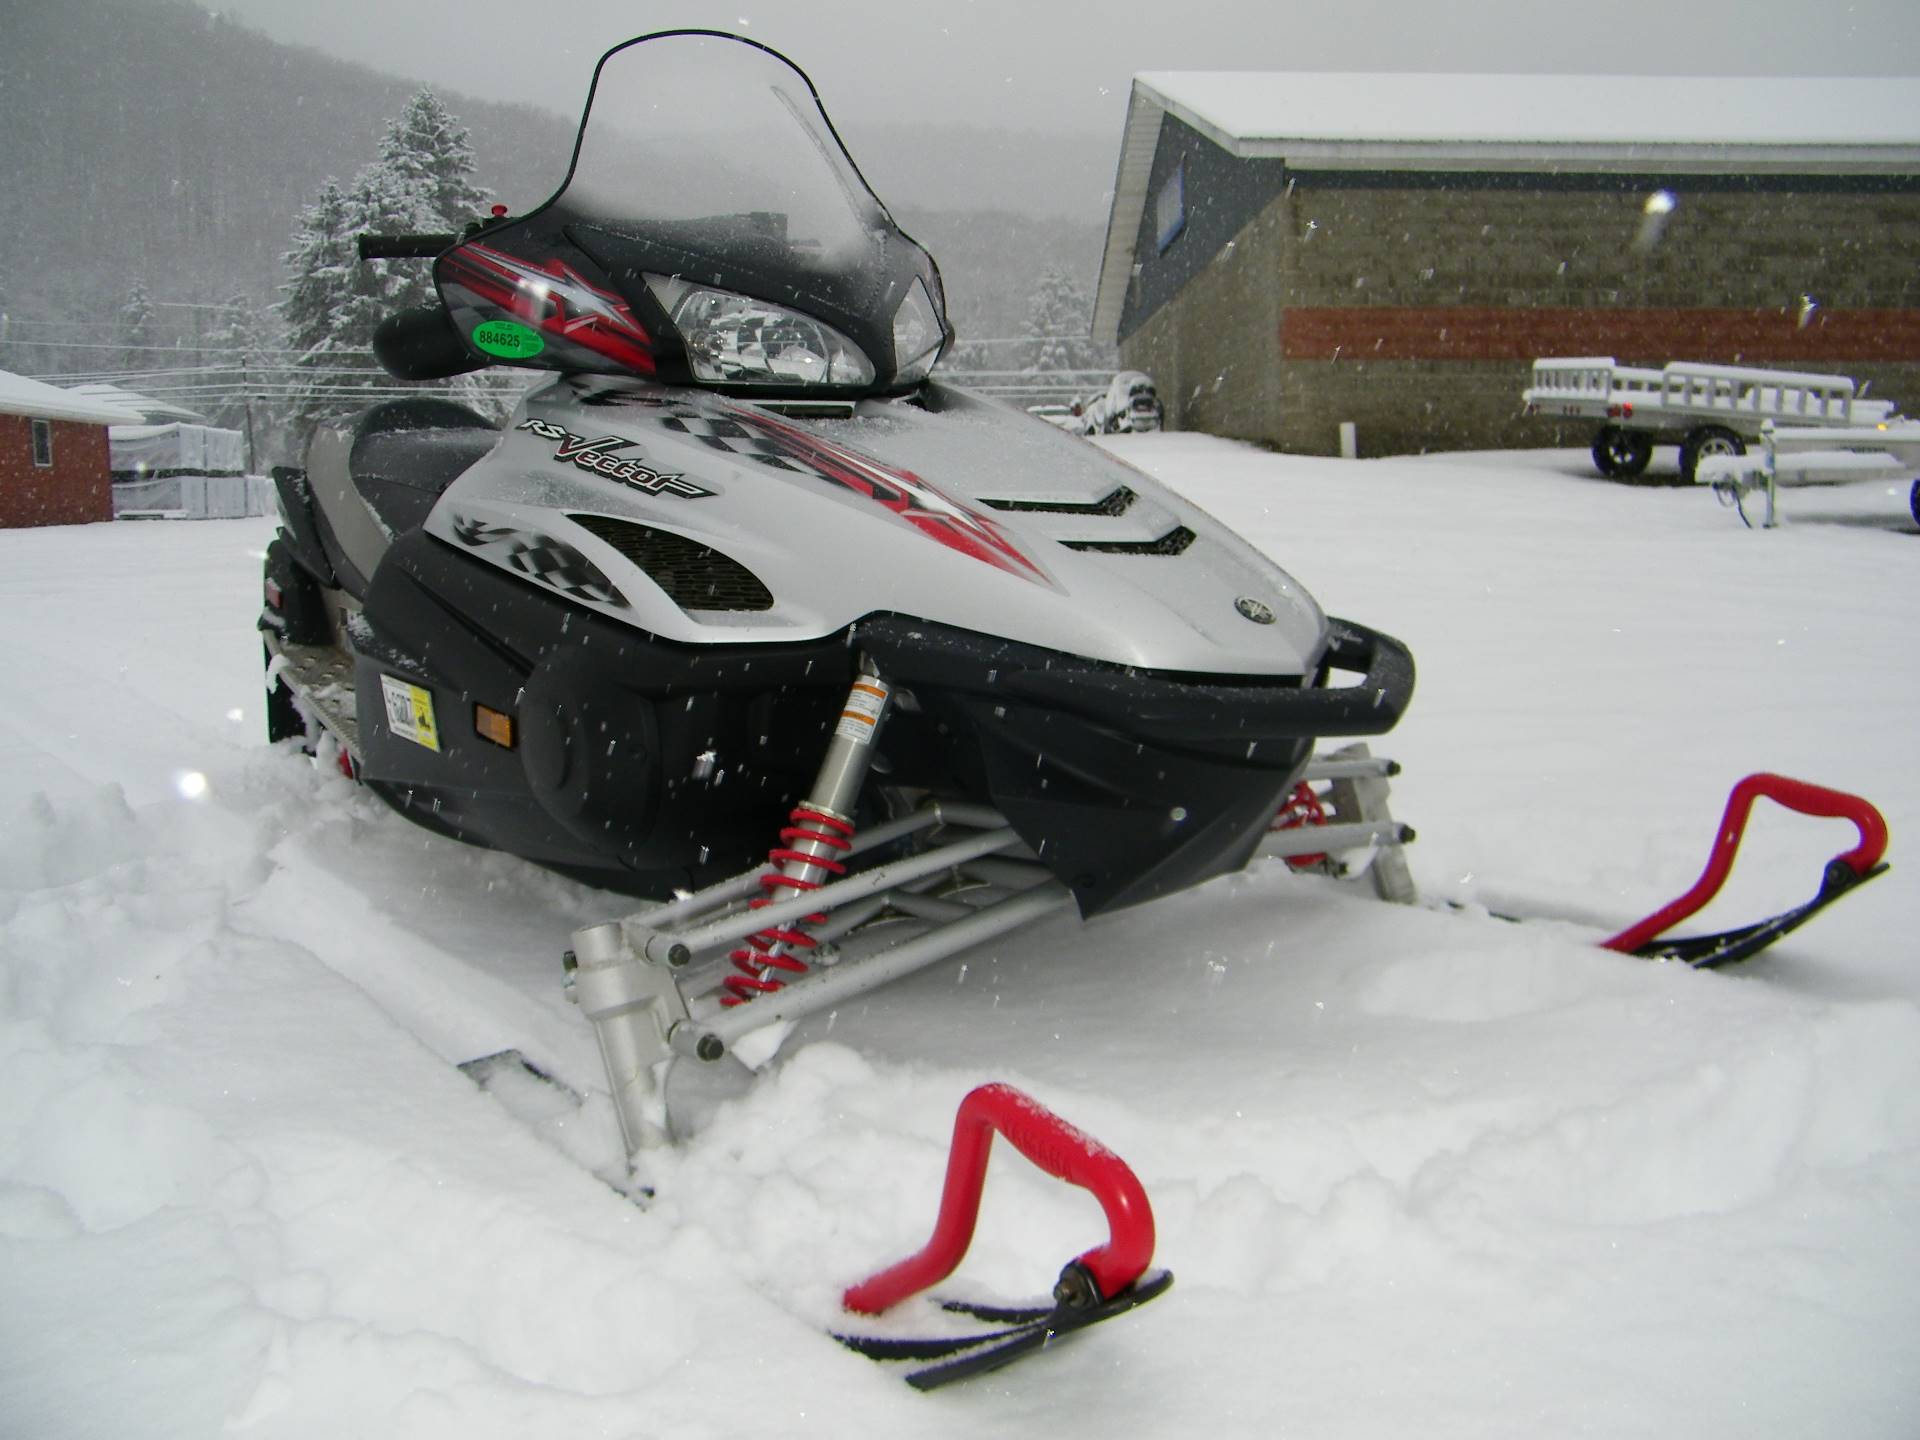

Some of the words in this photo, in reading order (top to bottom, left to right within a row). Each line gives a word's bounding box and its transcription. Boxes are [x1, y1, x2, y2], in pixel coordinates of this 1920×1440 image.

[479, 330, 520, 348] 884625
[515, 418, 568, 441] RS
[553, 434, 718, 499] Vector
